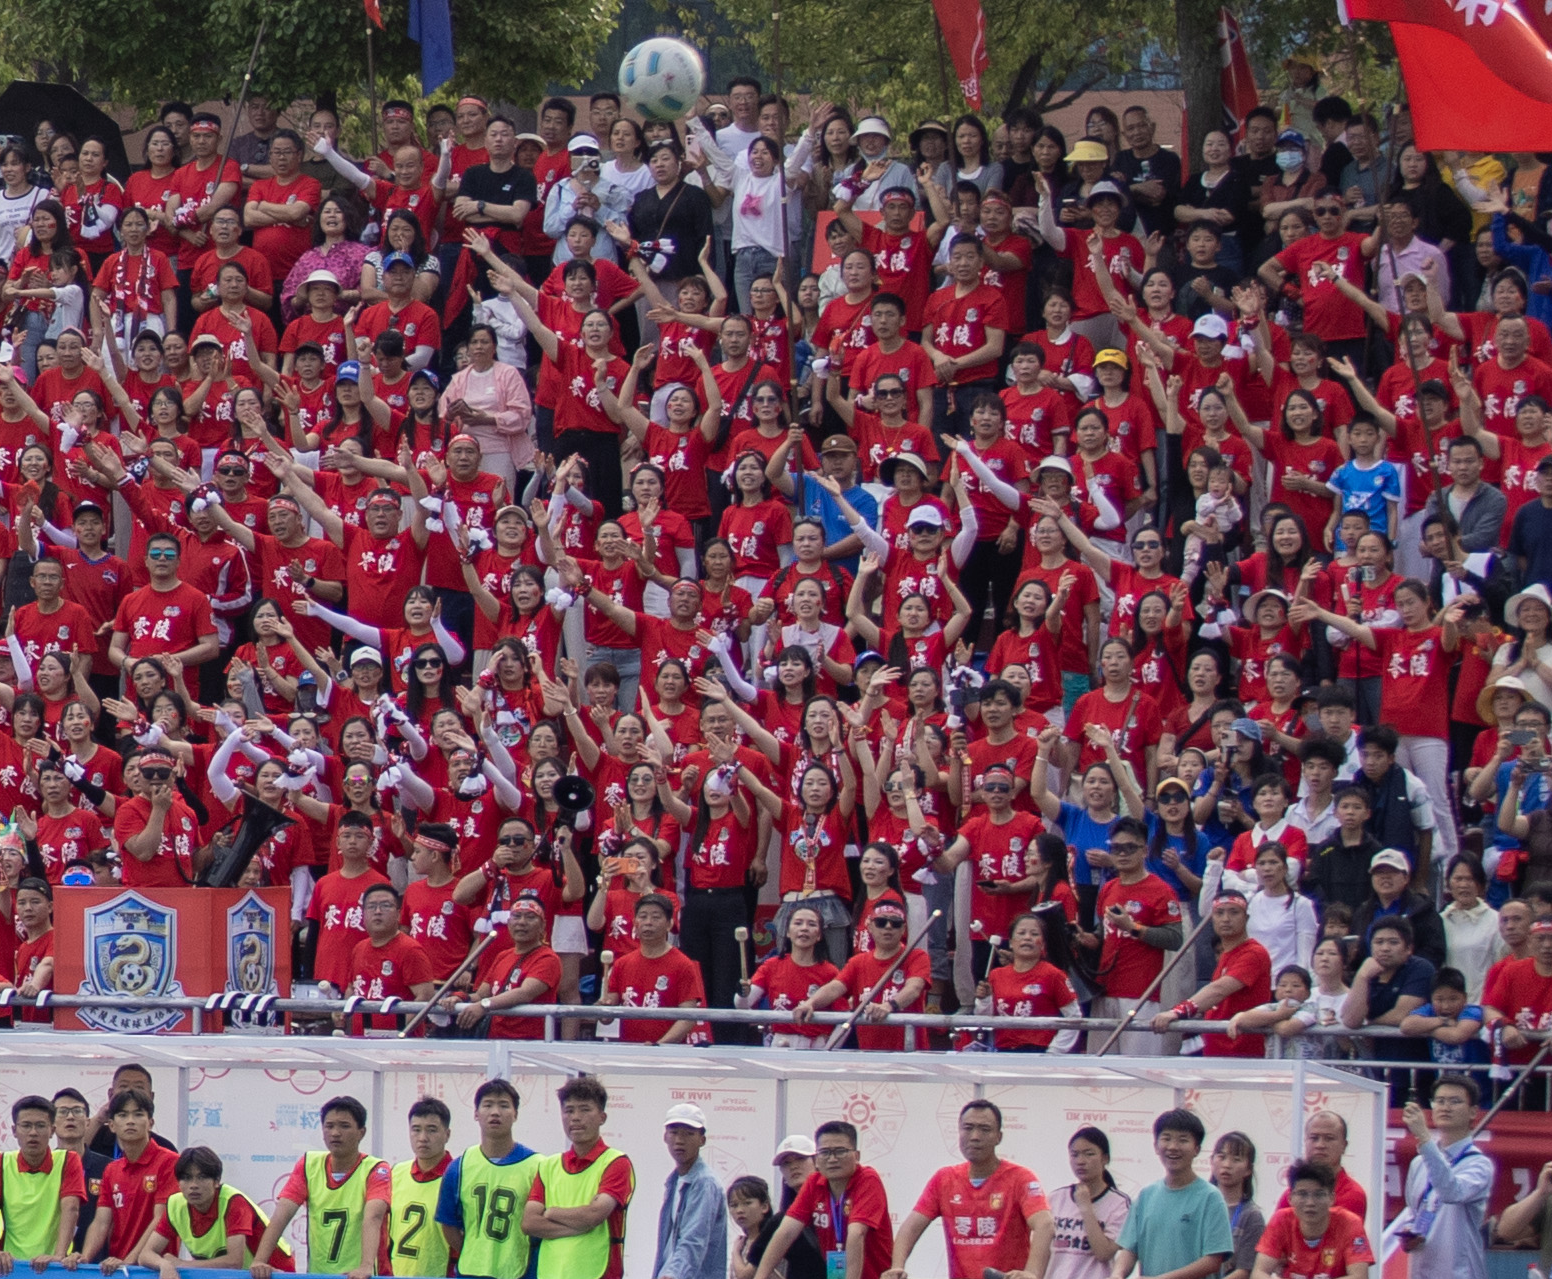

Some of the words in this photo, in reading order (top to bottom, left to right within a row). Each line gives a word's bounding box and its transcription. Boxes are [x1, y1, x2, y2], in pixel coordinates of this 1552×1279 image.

[935, 324, 973, 346] 零陵
[133, 617, 171, 642] 零陵
[1387, 653, 1430, 679] 零陵
[978, 853, 1023, 878] 零陵
[411, 915, 447, 940] 零陵
[352, 975, 384, 1000] 零陵
[472, 1182, 518, 1243] 18
[812, 1212, 830, 1230] 29
[321, 1207, 351, 1264] 7
[954, 1216, 997, 1237] 零陵
